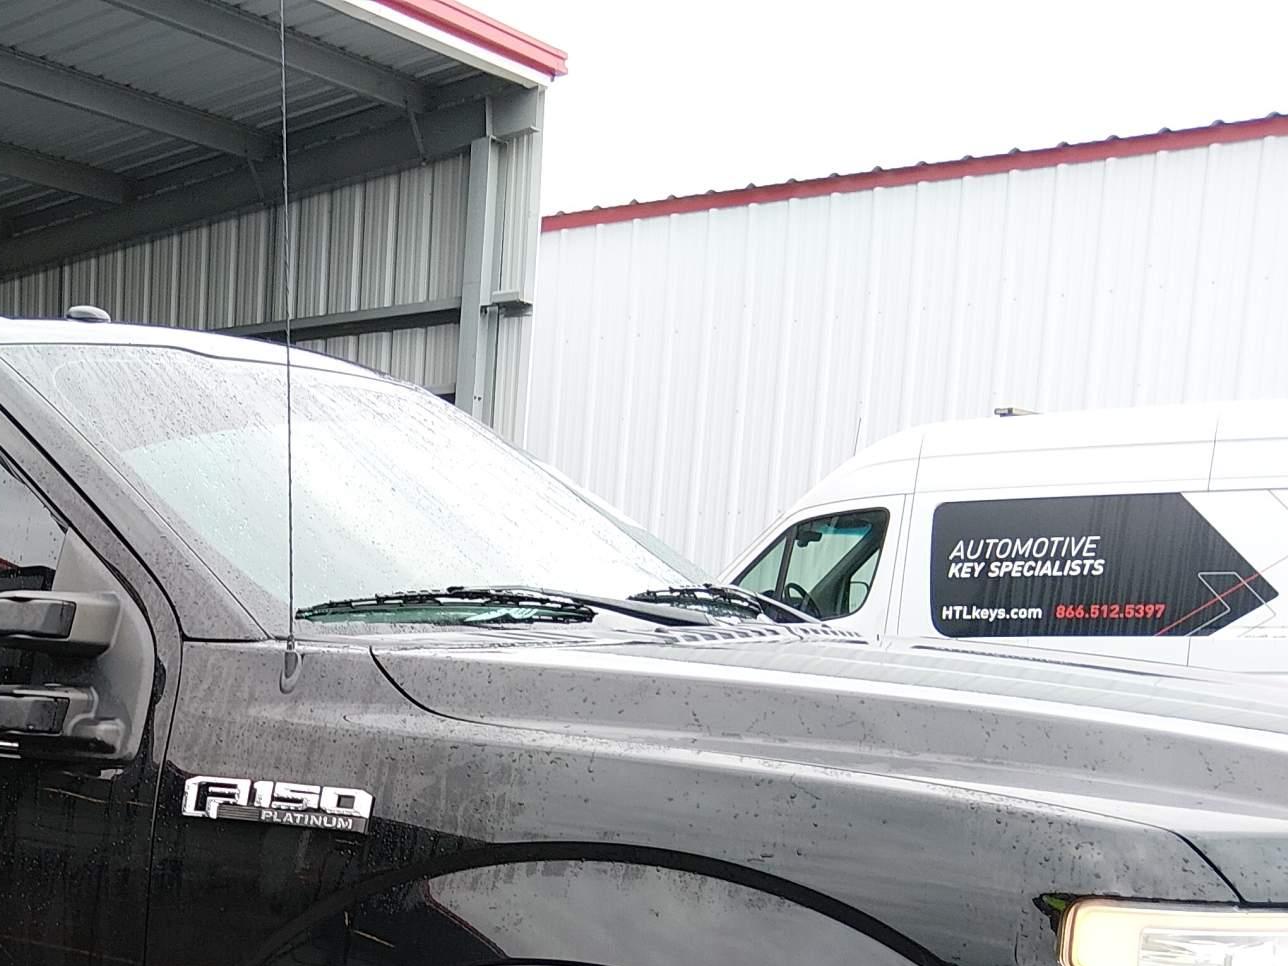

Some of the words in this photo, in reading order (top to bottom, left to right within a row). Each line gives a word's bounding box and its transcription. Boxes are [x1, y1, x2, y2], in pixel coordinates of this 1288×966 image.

[949, 535, 1101, 560] AUTOMOTIVE
[948, 561, 986, 579] KEY
[987, 559, 1105, 578] SPECIALISTS
[942, 605, 1043, 623] HTLkeys.com
[1055, 603, 1166, 620] 866.512.5397
[260, 808, 353, 831] PLATINUM
